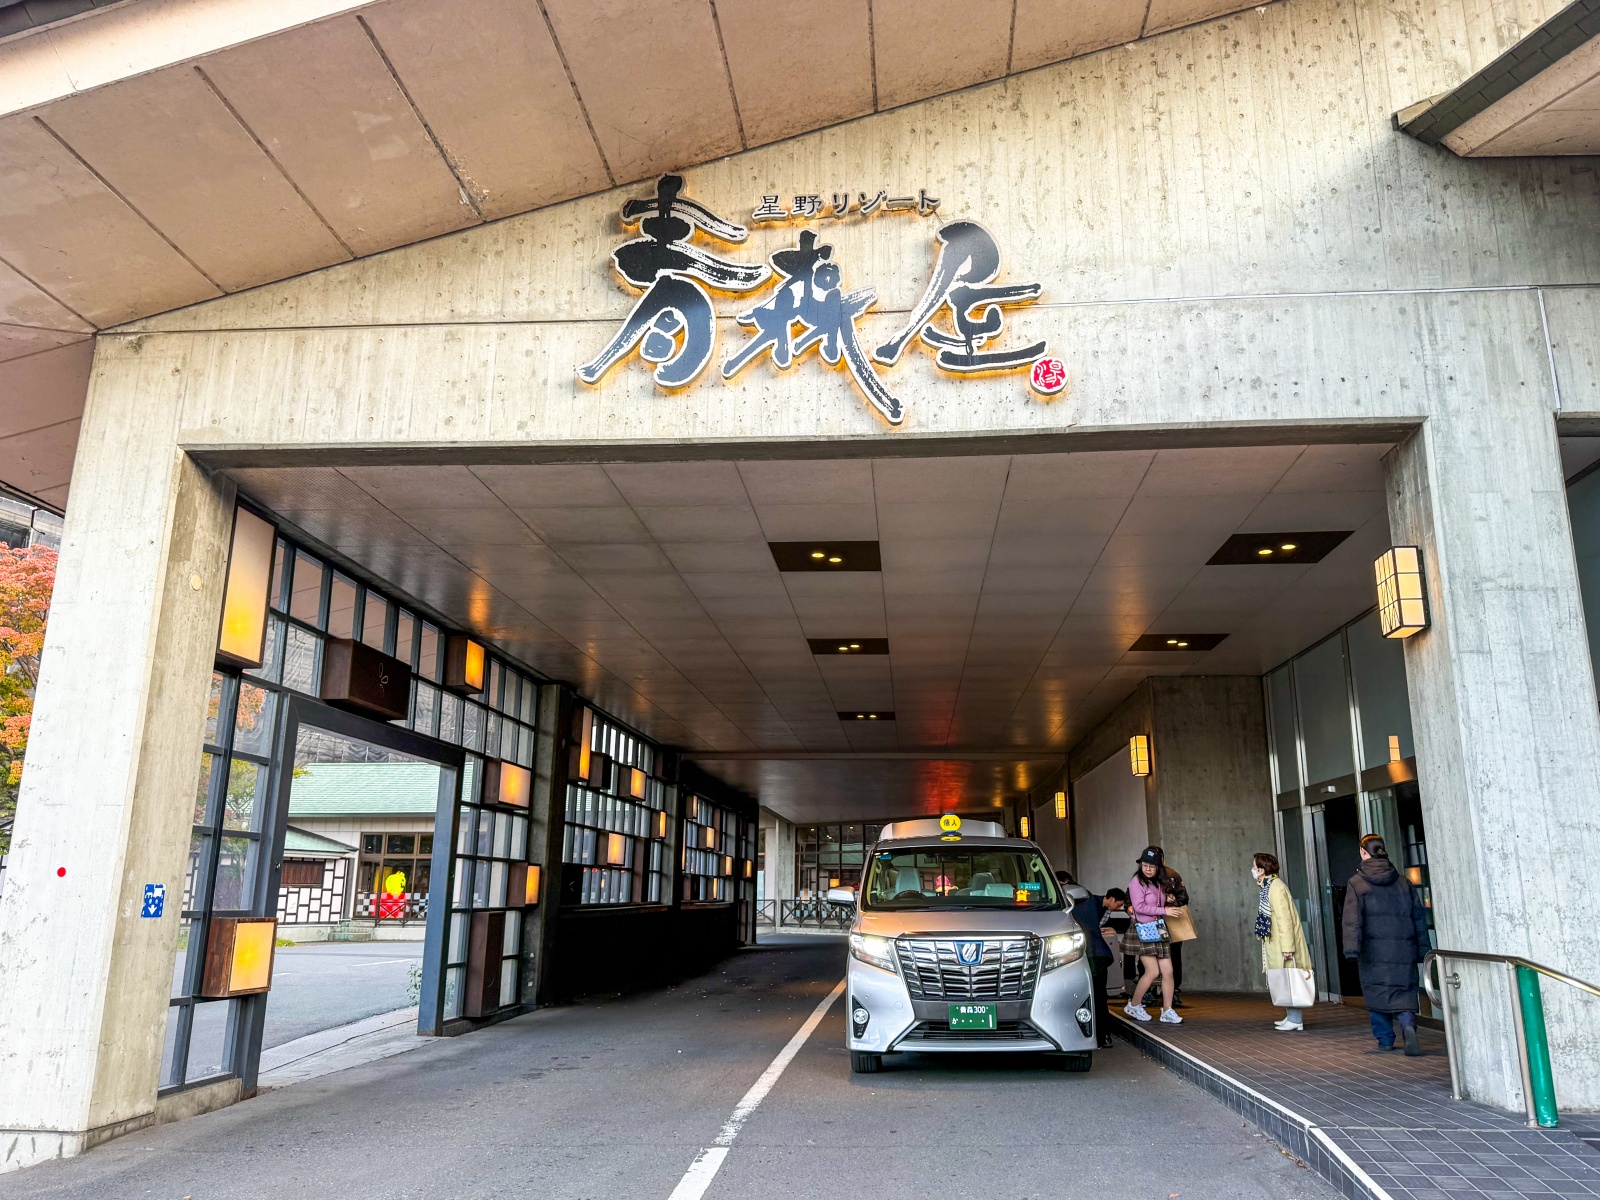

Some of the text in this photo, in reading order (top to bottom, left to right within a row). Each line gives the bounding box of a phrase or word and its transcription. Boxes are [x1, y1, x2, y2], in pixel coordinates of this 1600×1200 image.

[753, 188, 940, 217] 星野リゾート
